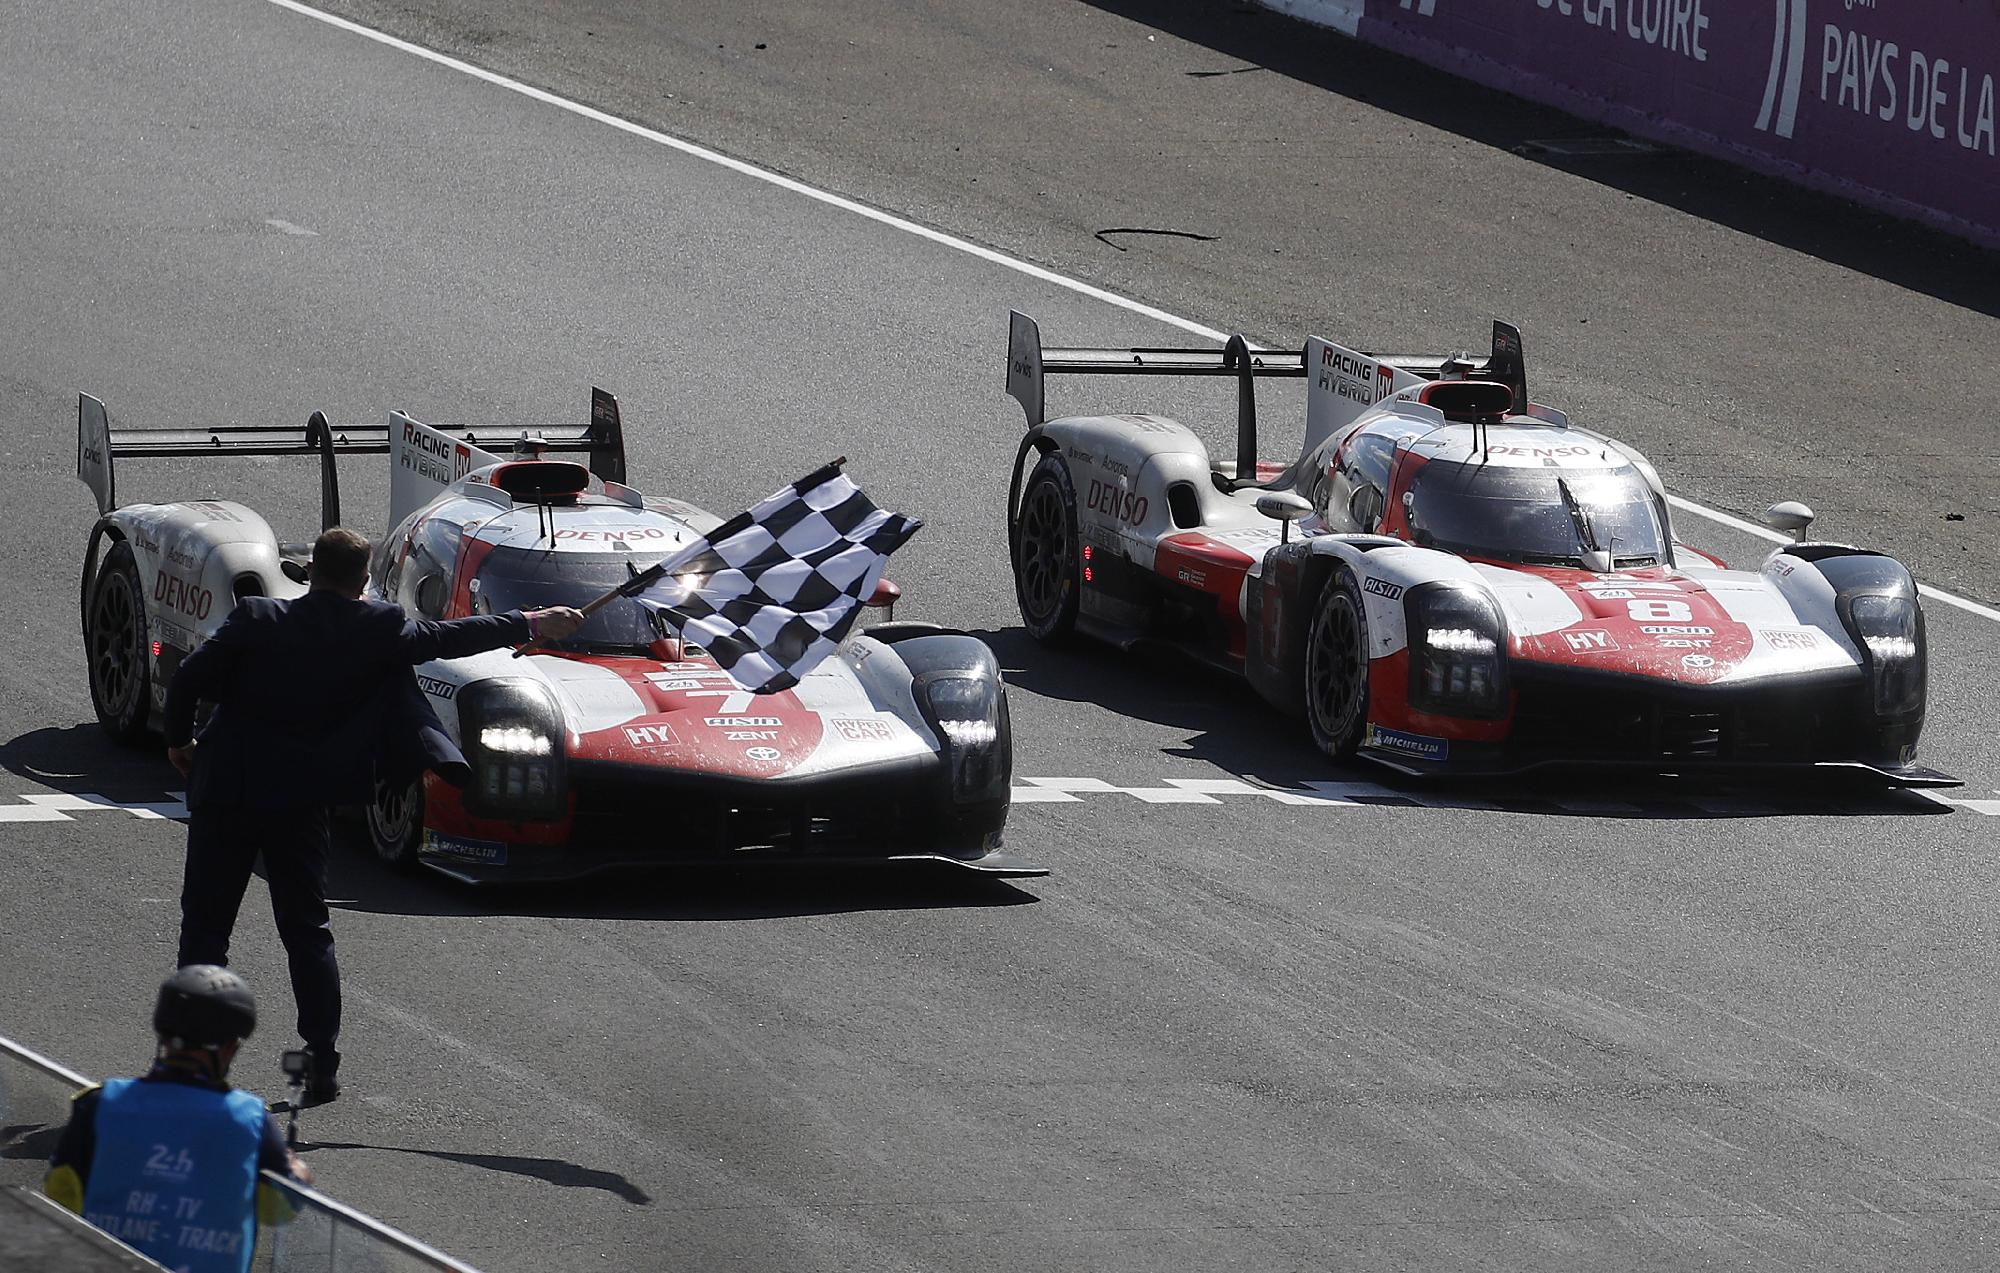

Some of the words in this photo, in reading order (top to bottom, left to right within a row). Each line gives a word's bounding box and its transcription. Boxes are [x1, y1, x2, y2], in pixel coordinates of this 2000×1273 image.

[1821, 24, 1899, 121] PAYS
[1906, 51, 1950, 139] DE
[1957, 67, 1995, 156] LA
[1322, 345, 1371, 381] RACING
[1319, 368, 1372, 406] HYBRID
[403, 422, 449, 459] RACING
[1487, 446, 1590, 457] DENSO
[401, 446, 450, 486] HYBRID
[1088, 480, 1149, 526] DENSO
[554, 528, 664, 541] DENSO
[155, 570, 212, 620] DENSO
[1365, 578, 1402, 599] AISIN
[1627, 600, 1692, 622] 8
[1565, 631, 1605, 649] HY
[1661, 638, 1712, 648] ZENT
[1764, 631, 1812, 640] HYPER
[686, 690, 755, 713] 7
[626, 725, 668, 745] HY
[836, 720, 887, 730] HYPER
[724, 731, 778, 741] ZENT
[1383, 734, 1439, 754] MICHELIN
[440, 841, 497, 858] MICHELIN
[176, 1197, 204, 1220] TV
[178, 1225, 241, 1255] TRACK
